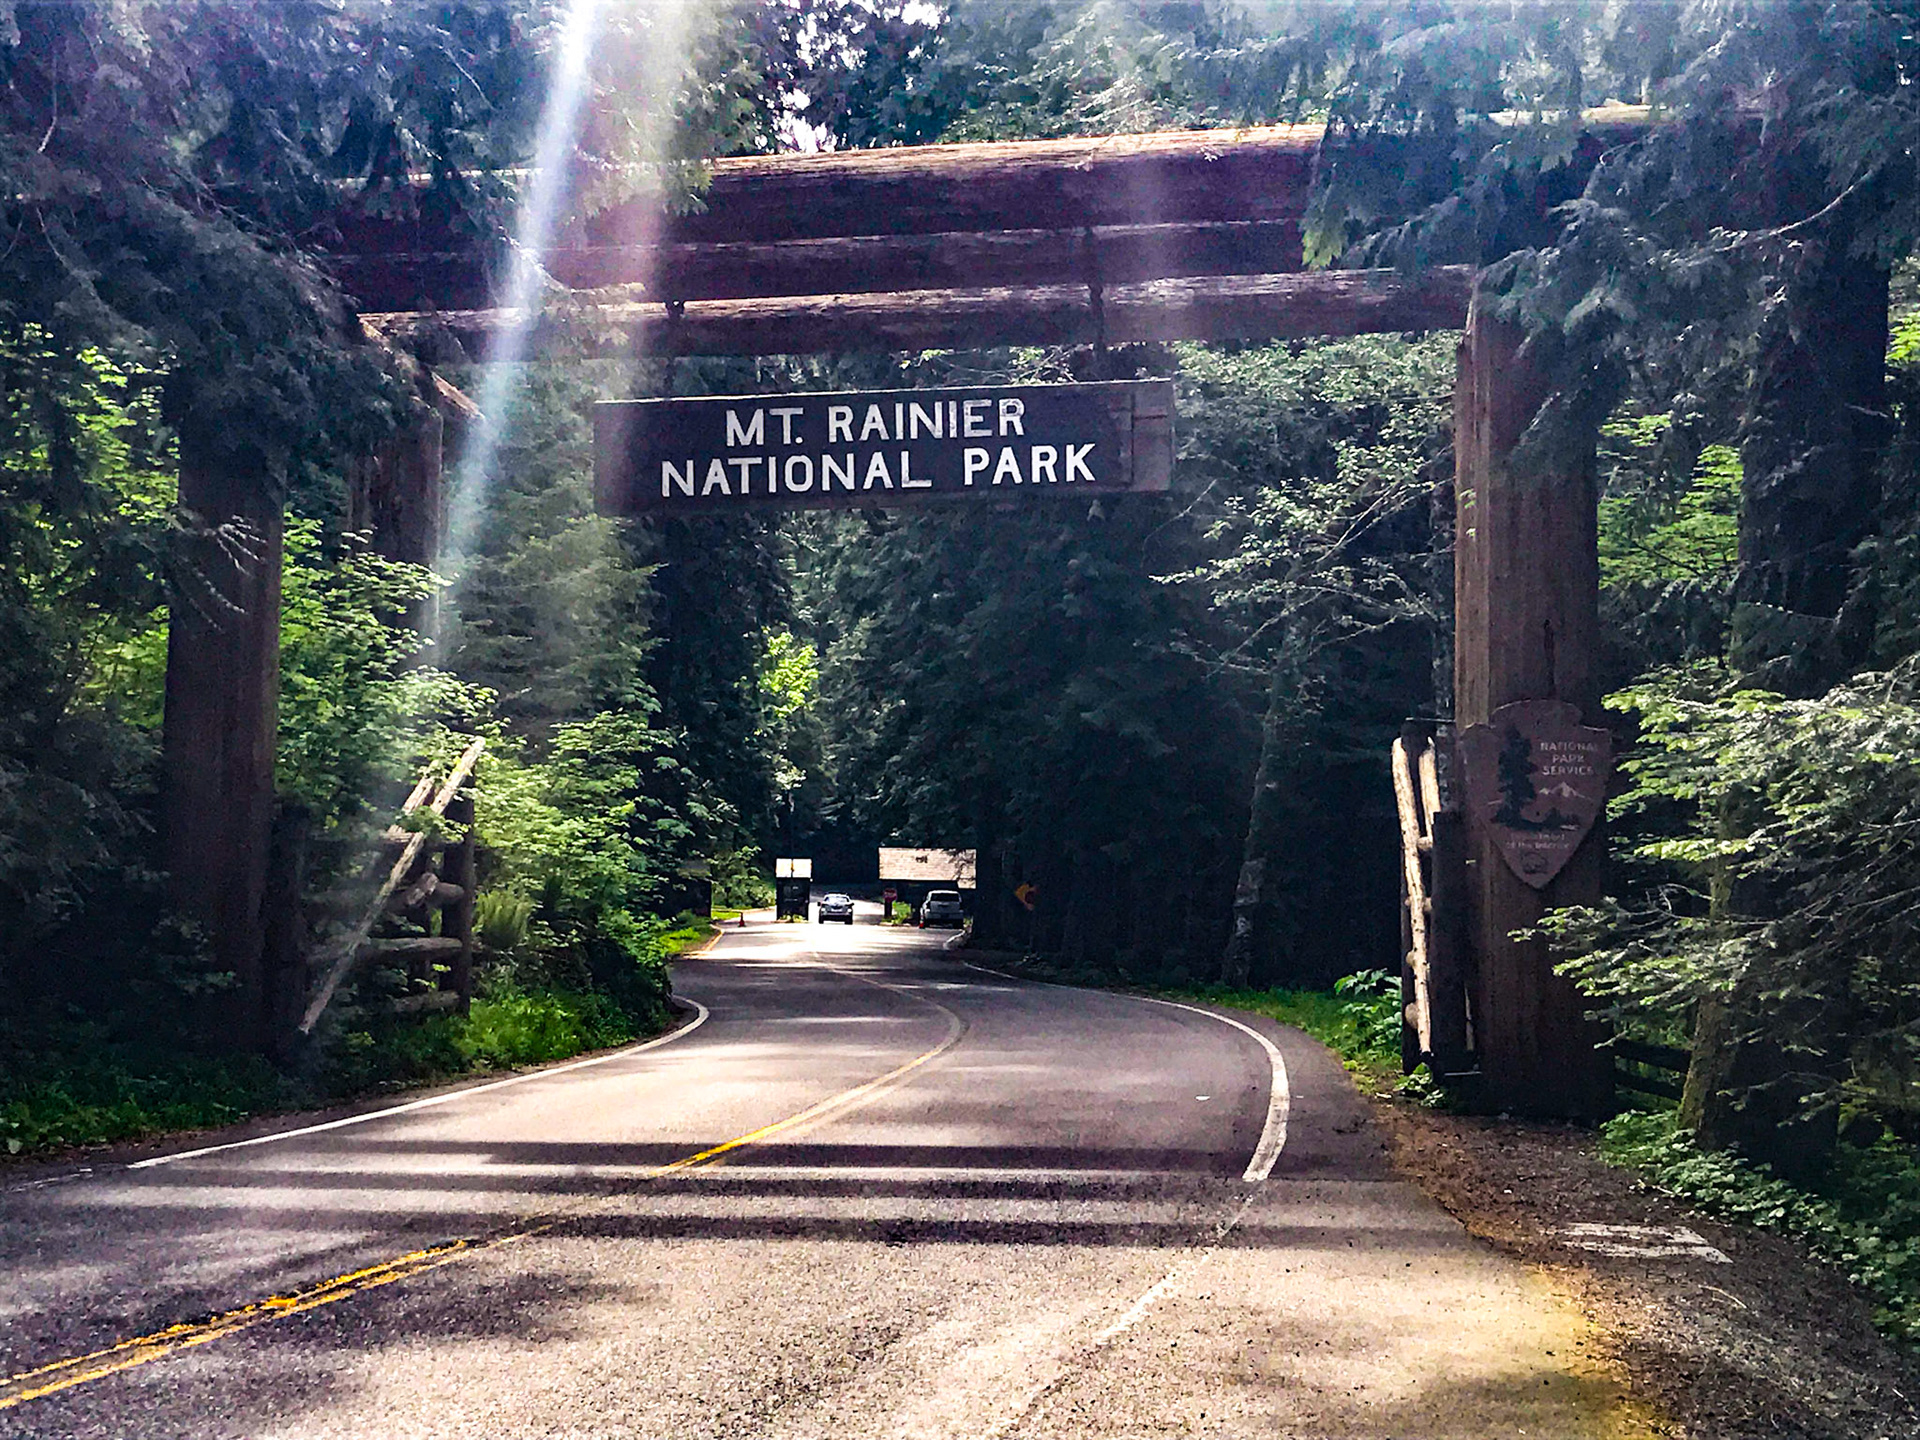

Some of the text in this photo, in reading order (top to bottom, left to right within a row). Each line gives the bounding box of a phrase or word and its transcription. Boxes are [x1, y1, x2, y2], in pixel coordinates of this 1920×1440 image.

[726, 398, 1025, 447] MT. RAINIER
[661, 443, 1096, 498] NATIONAL PARK
[1542, 765, 1594, 776] SERVICE
[1552, 754, 1585, 763] PARK
